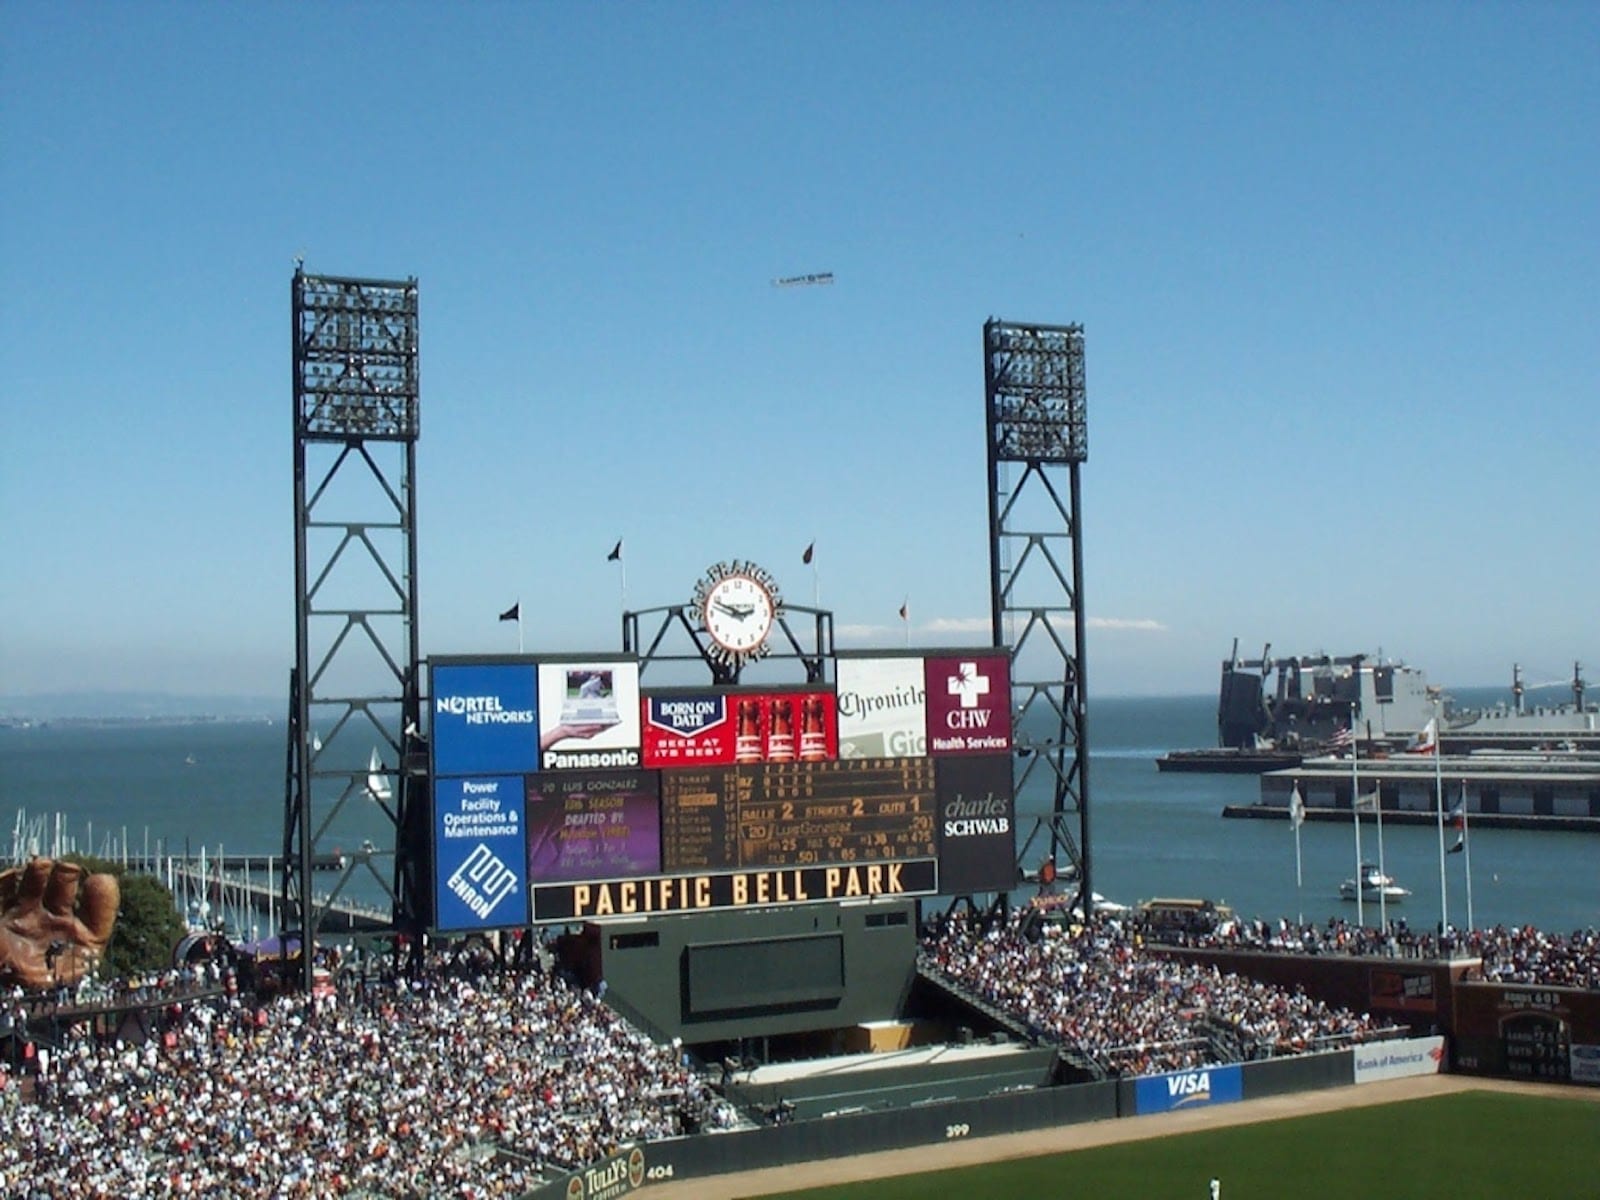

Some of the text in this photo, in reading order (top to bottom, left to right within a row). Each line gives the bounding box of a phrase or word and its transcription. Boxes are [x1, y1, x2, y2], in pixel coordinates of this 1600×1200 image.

[436, 695, 503, 714] NORTEL
[660, 701, 715, 716] BORN ON
[466, 709, 534, 724] NETWORKS
[672, 714, 704, 728] DATE
[946, 709, 992, 729] CHW
[658, 738, 720, 748] BEER AT
[933, 735, 1007, 751] Health Services
[543, 749, 639, 769] Panasonic
[685, 747, 723, 757] BEST
[462, 781, 499, 794] Power
[562, 782, 583, 792] LUIS
[586, 779, 638, 792] GONZALEZ
[461, 798, 501, 812] Facility
[781, 801, 795, 821] 2
[852, 797, 865, 817] 2
[911, 795, 920, 813] 1
[944, 792, 1009, 818] charles
[443, 810, 518, 827] Operations &
[444, 824, 519, 838] Maintenance
[944, 818, 1009, 837] SCHWAB
[447, 875, 489, 920] ENRON
[573, 862, 905, 918] PACIFIC BELL PARK
[1356, 1053, 1423, 1071] Bank of America
[1167, 1071, 1210, 1096] VISA
[946, 1123, 970, 1138] 399
[647, 1164, 673, 1179] 404
